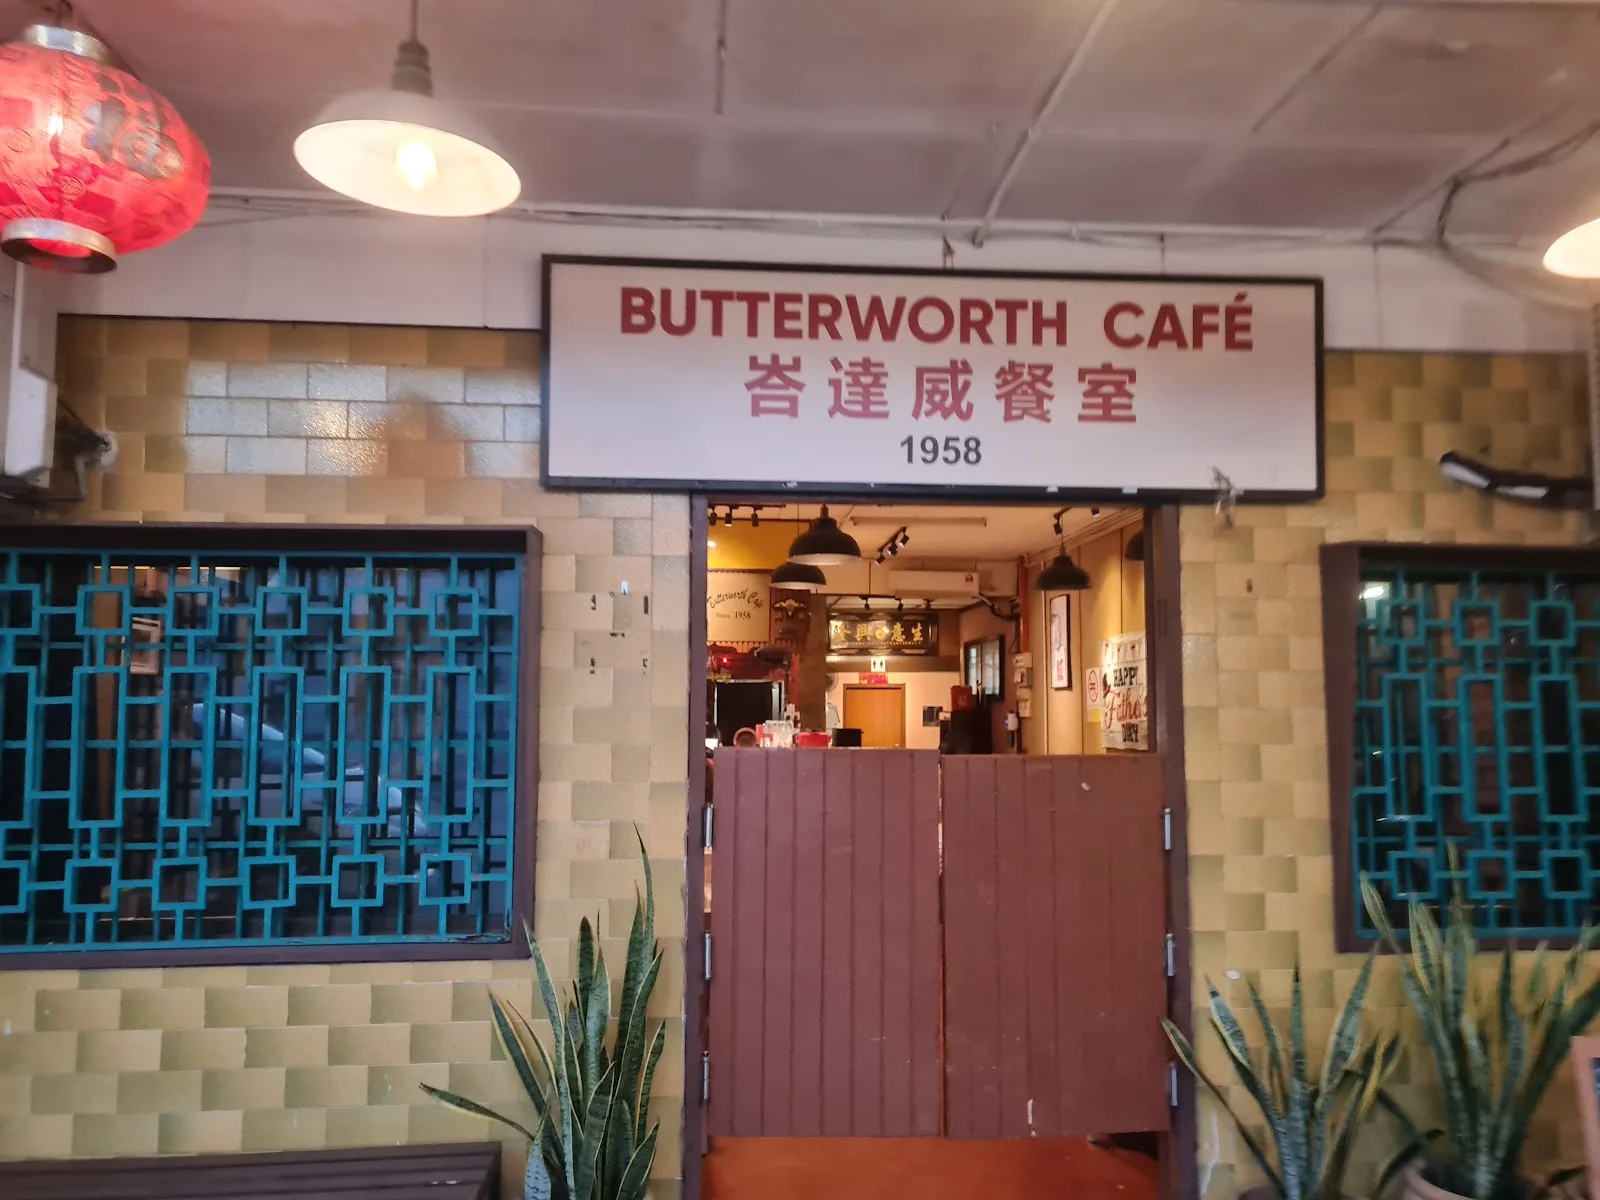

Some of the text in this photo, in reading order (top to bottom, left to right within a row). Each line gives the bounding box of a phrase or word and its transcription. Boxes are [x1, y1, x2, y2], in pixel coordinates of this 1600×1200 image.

[621, 286, 1253, 350] BUTTERWORTH CAFÉ
[744, 354, 1137, 423] 峇達威餐室
[900, 435, 982, 466] 1958
[735, 611, 751, 620] 1958
[1121, 723, 1139, 743] DAY
